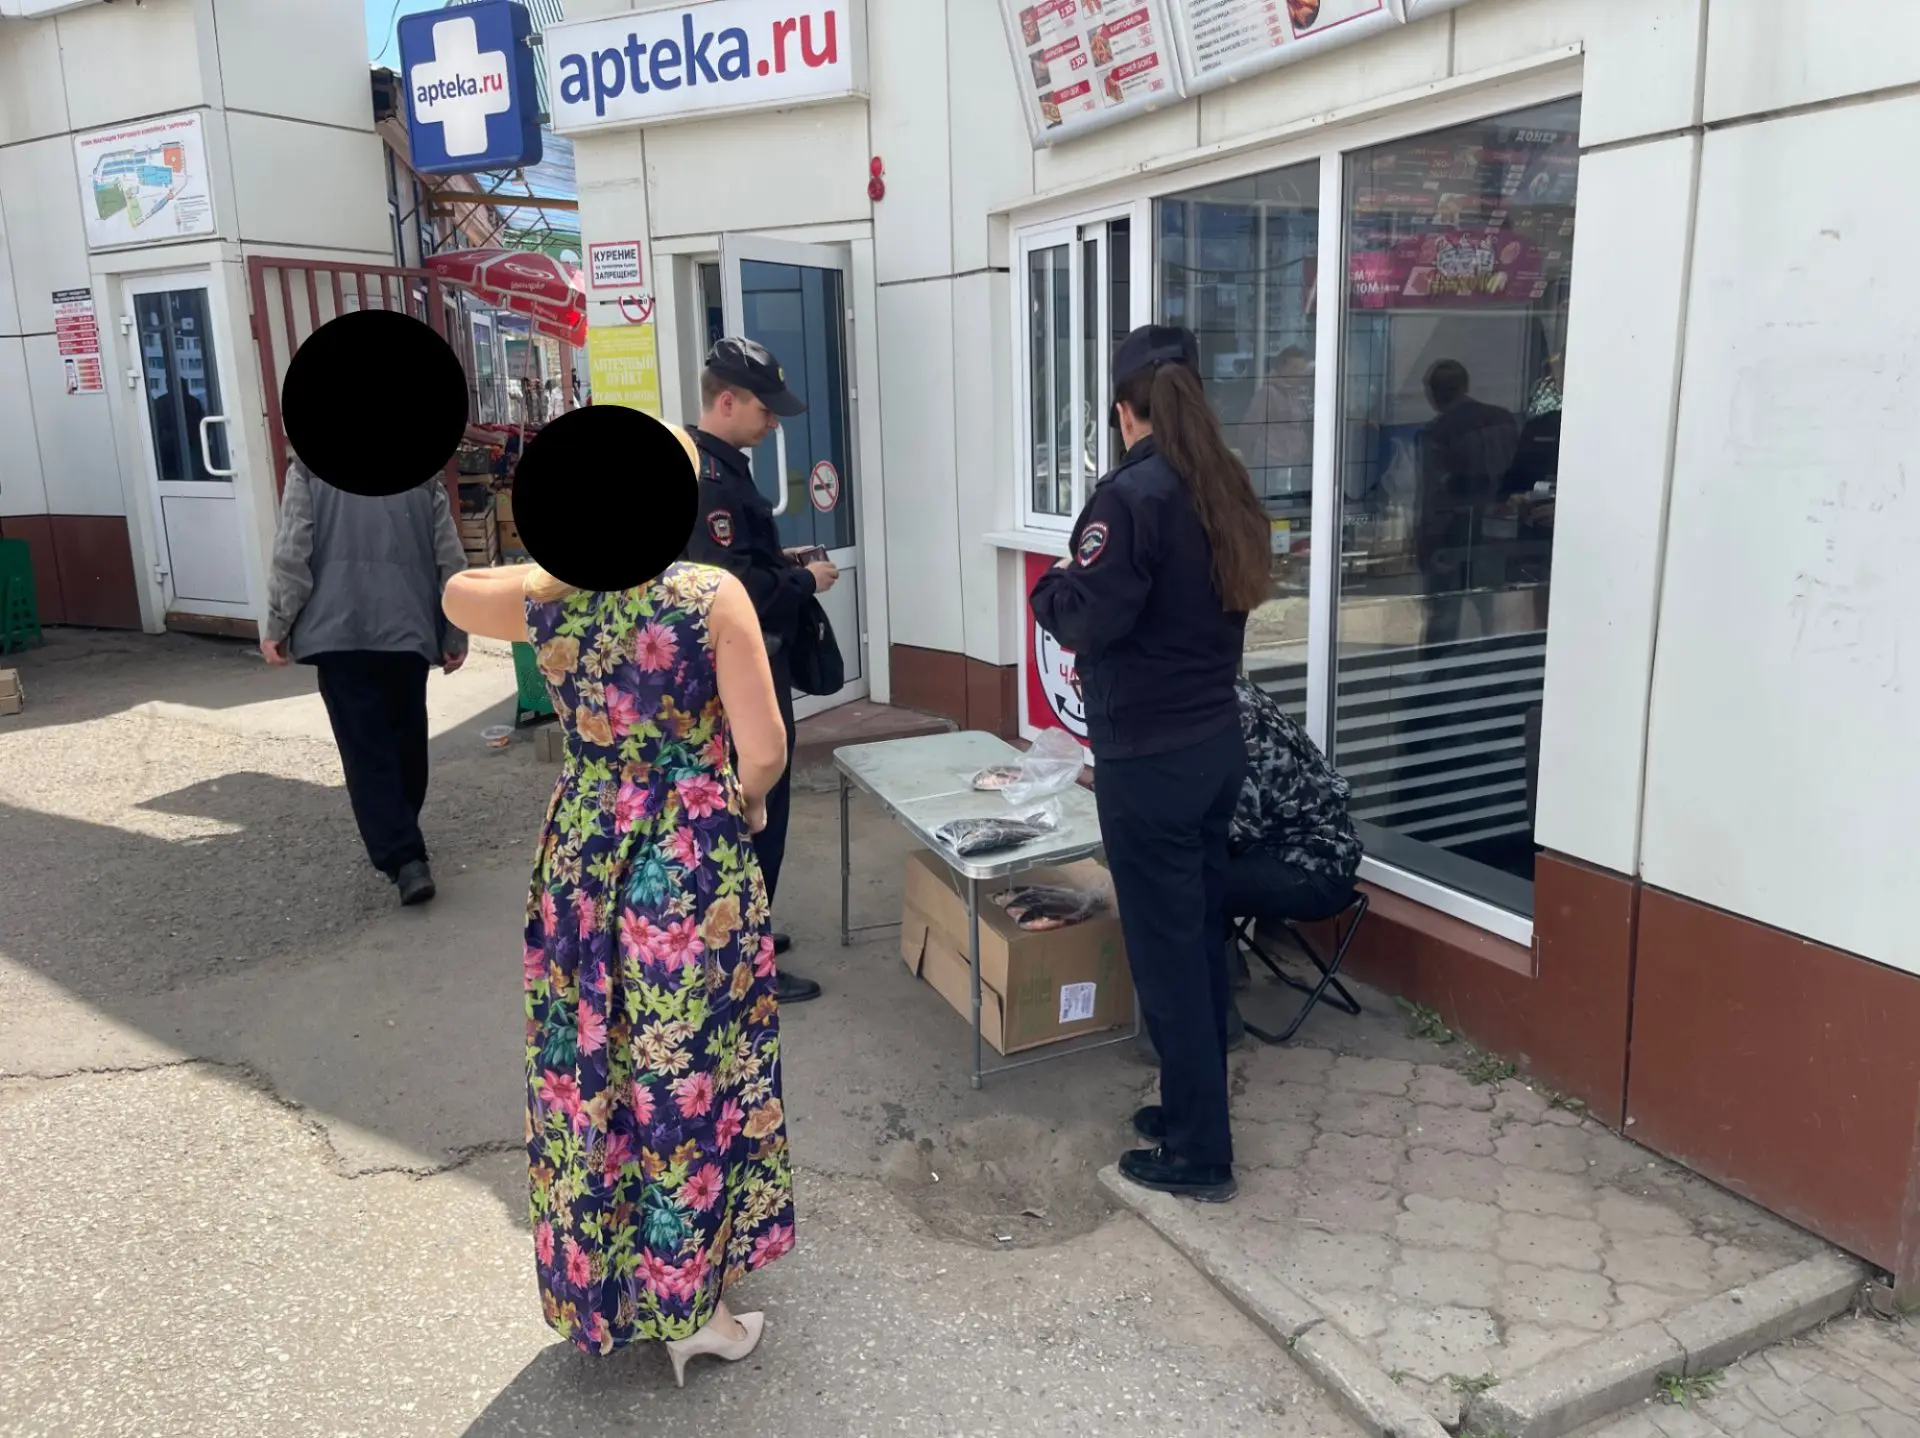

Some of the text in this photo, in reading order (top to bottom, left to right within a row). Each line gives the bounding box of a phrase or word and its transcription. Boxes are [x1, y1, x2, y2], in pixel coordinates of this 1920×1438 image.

[559, 10, 838, 117] apteka.ru
[417, 73, 503, 107] apteka.ru
[594, 249, 636, 262] КУРЕНИЕ
[595, 269, 638, 281] ЗАПРЕЩЕНО!
[1060, 663, 1080, 685] ЧА
